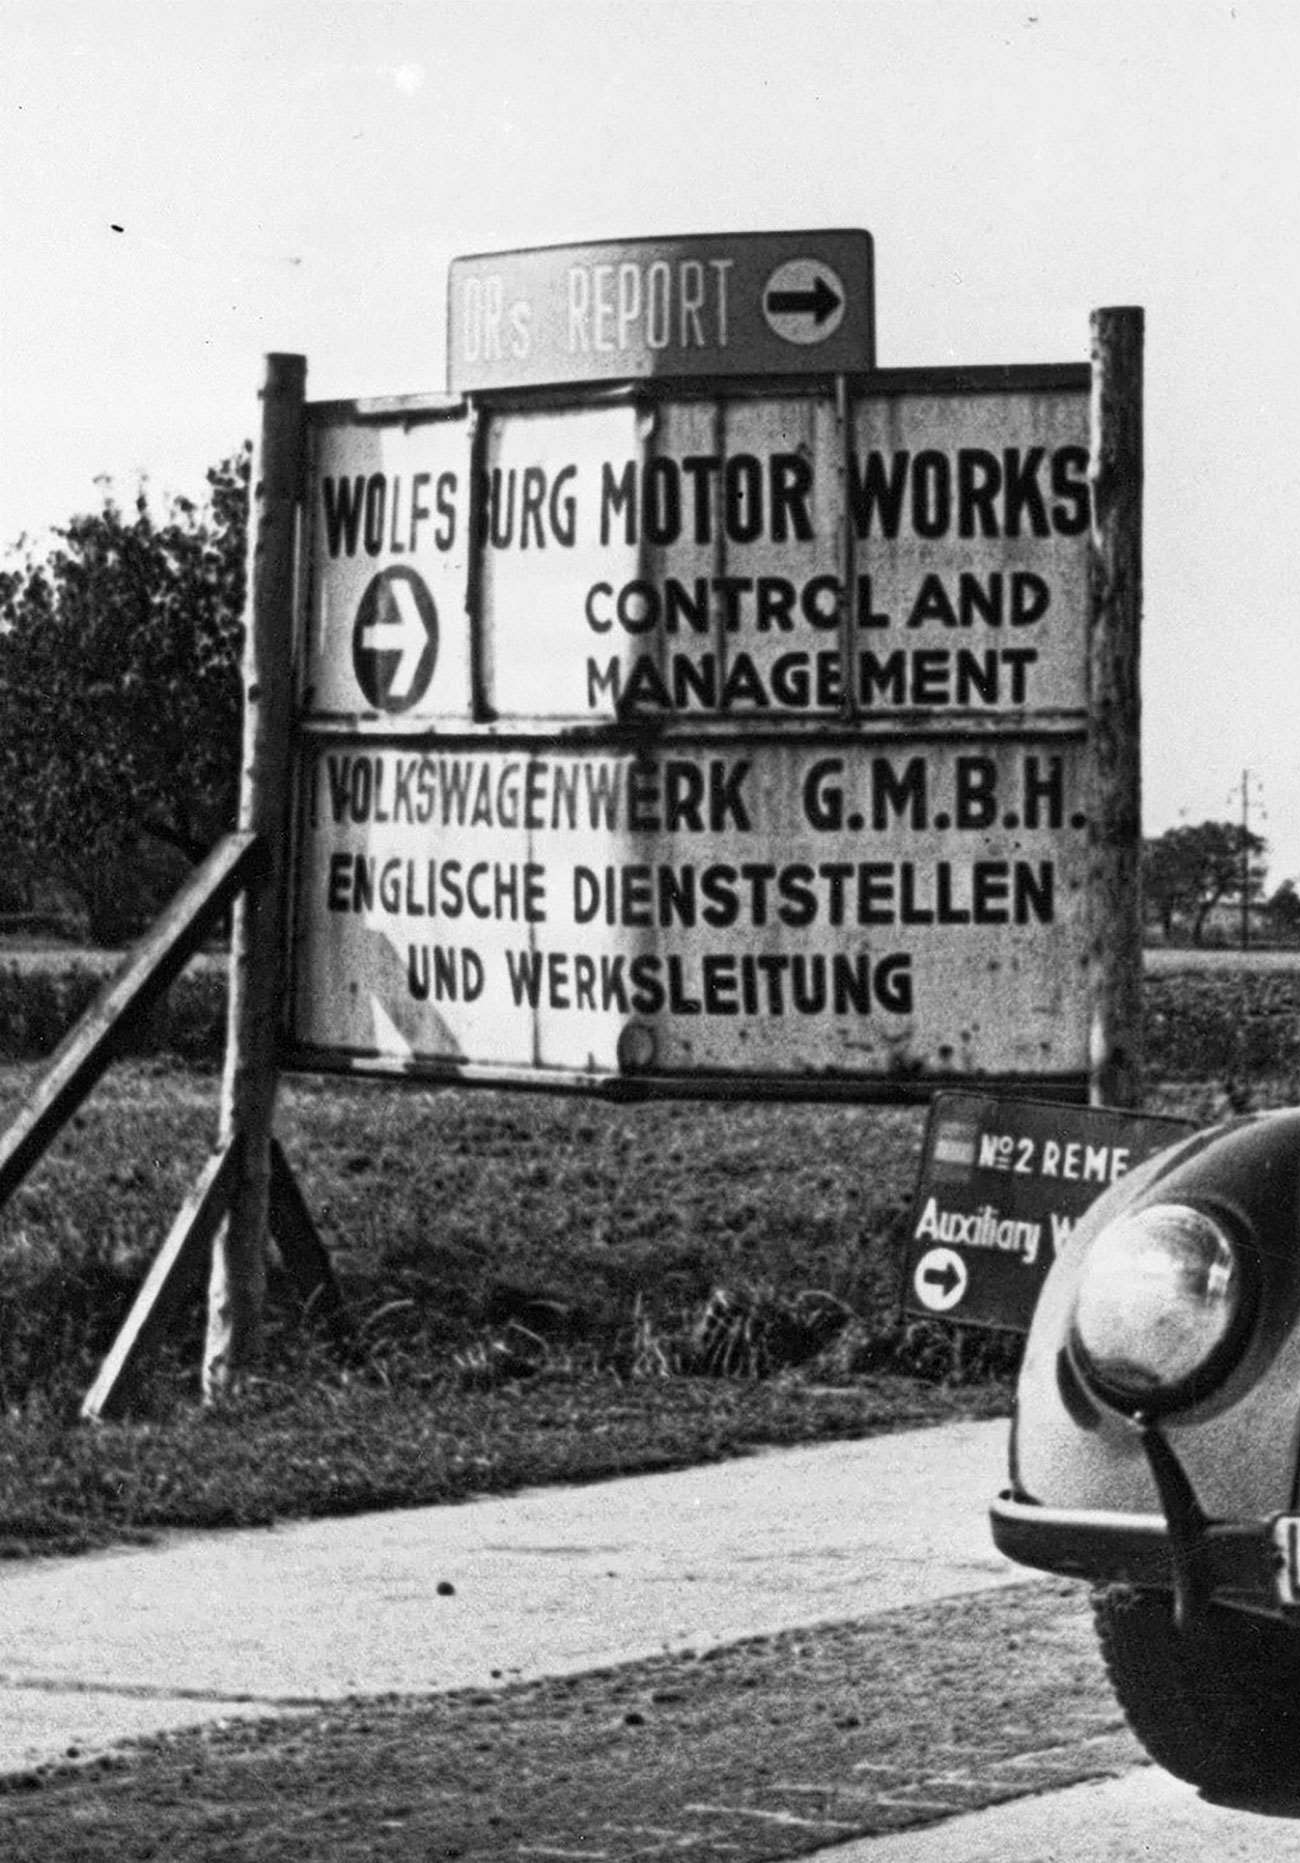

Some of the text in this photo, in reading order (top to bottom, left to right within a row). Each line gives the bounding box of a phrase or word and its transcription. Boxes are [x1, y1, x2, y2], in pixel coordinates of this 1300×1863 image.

[566, 258, 734, 352] REPORT
[601, 453, 814, 547] MOTOR
[848, 444, 1092, 541] WORKS
[585, 571, 1051, 634] CONTROL AND
[587, 648, 1039, 709] MANAGEMENT
[326, 756, 1087, 833] VOLKSWAGENWERK G.M.B.H.
[326, 852, 1054, 928] ENGLISCHE DIENSTSTELLEN
[408, 944, 913, 1016] UND WERKSLEITUNG
[1042, 1140, 1130, 1182] REME
[914, 1196, 1042, 1265] Auxiliary
